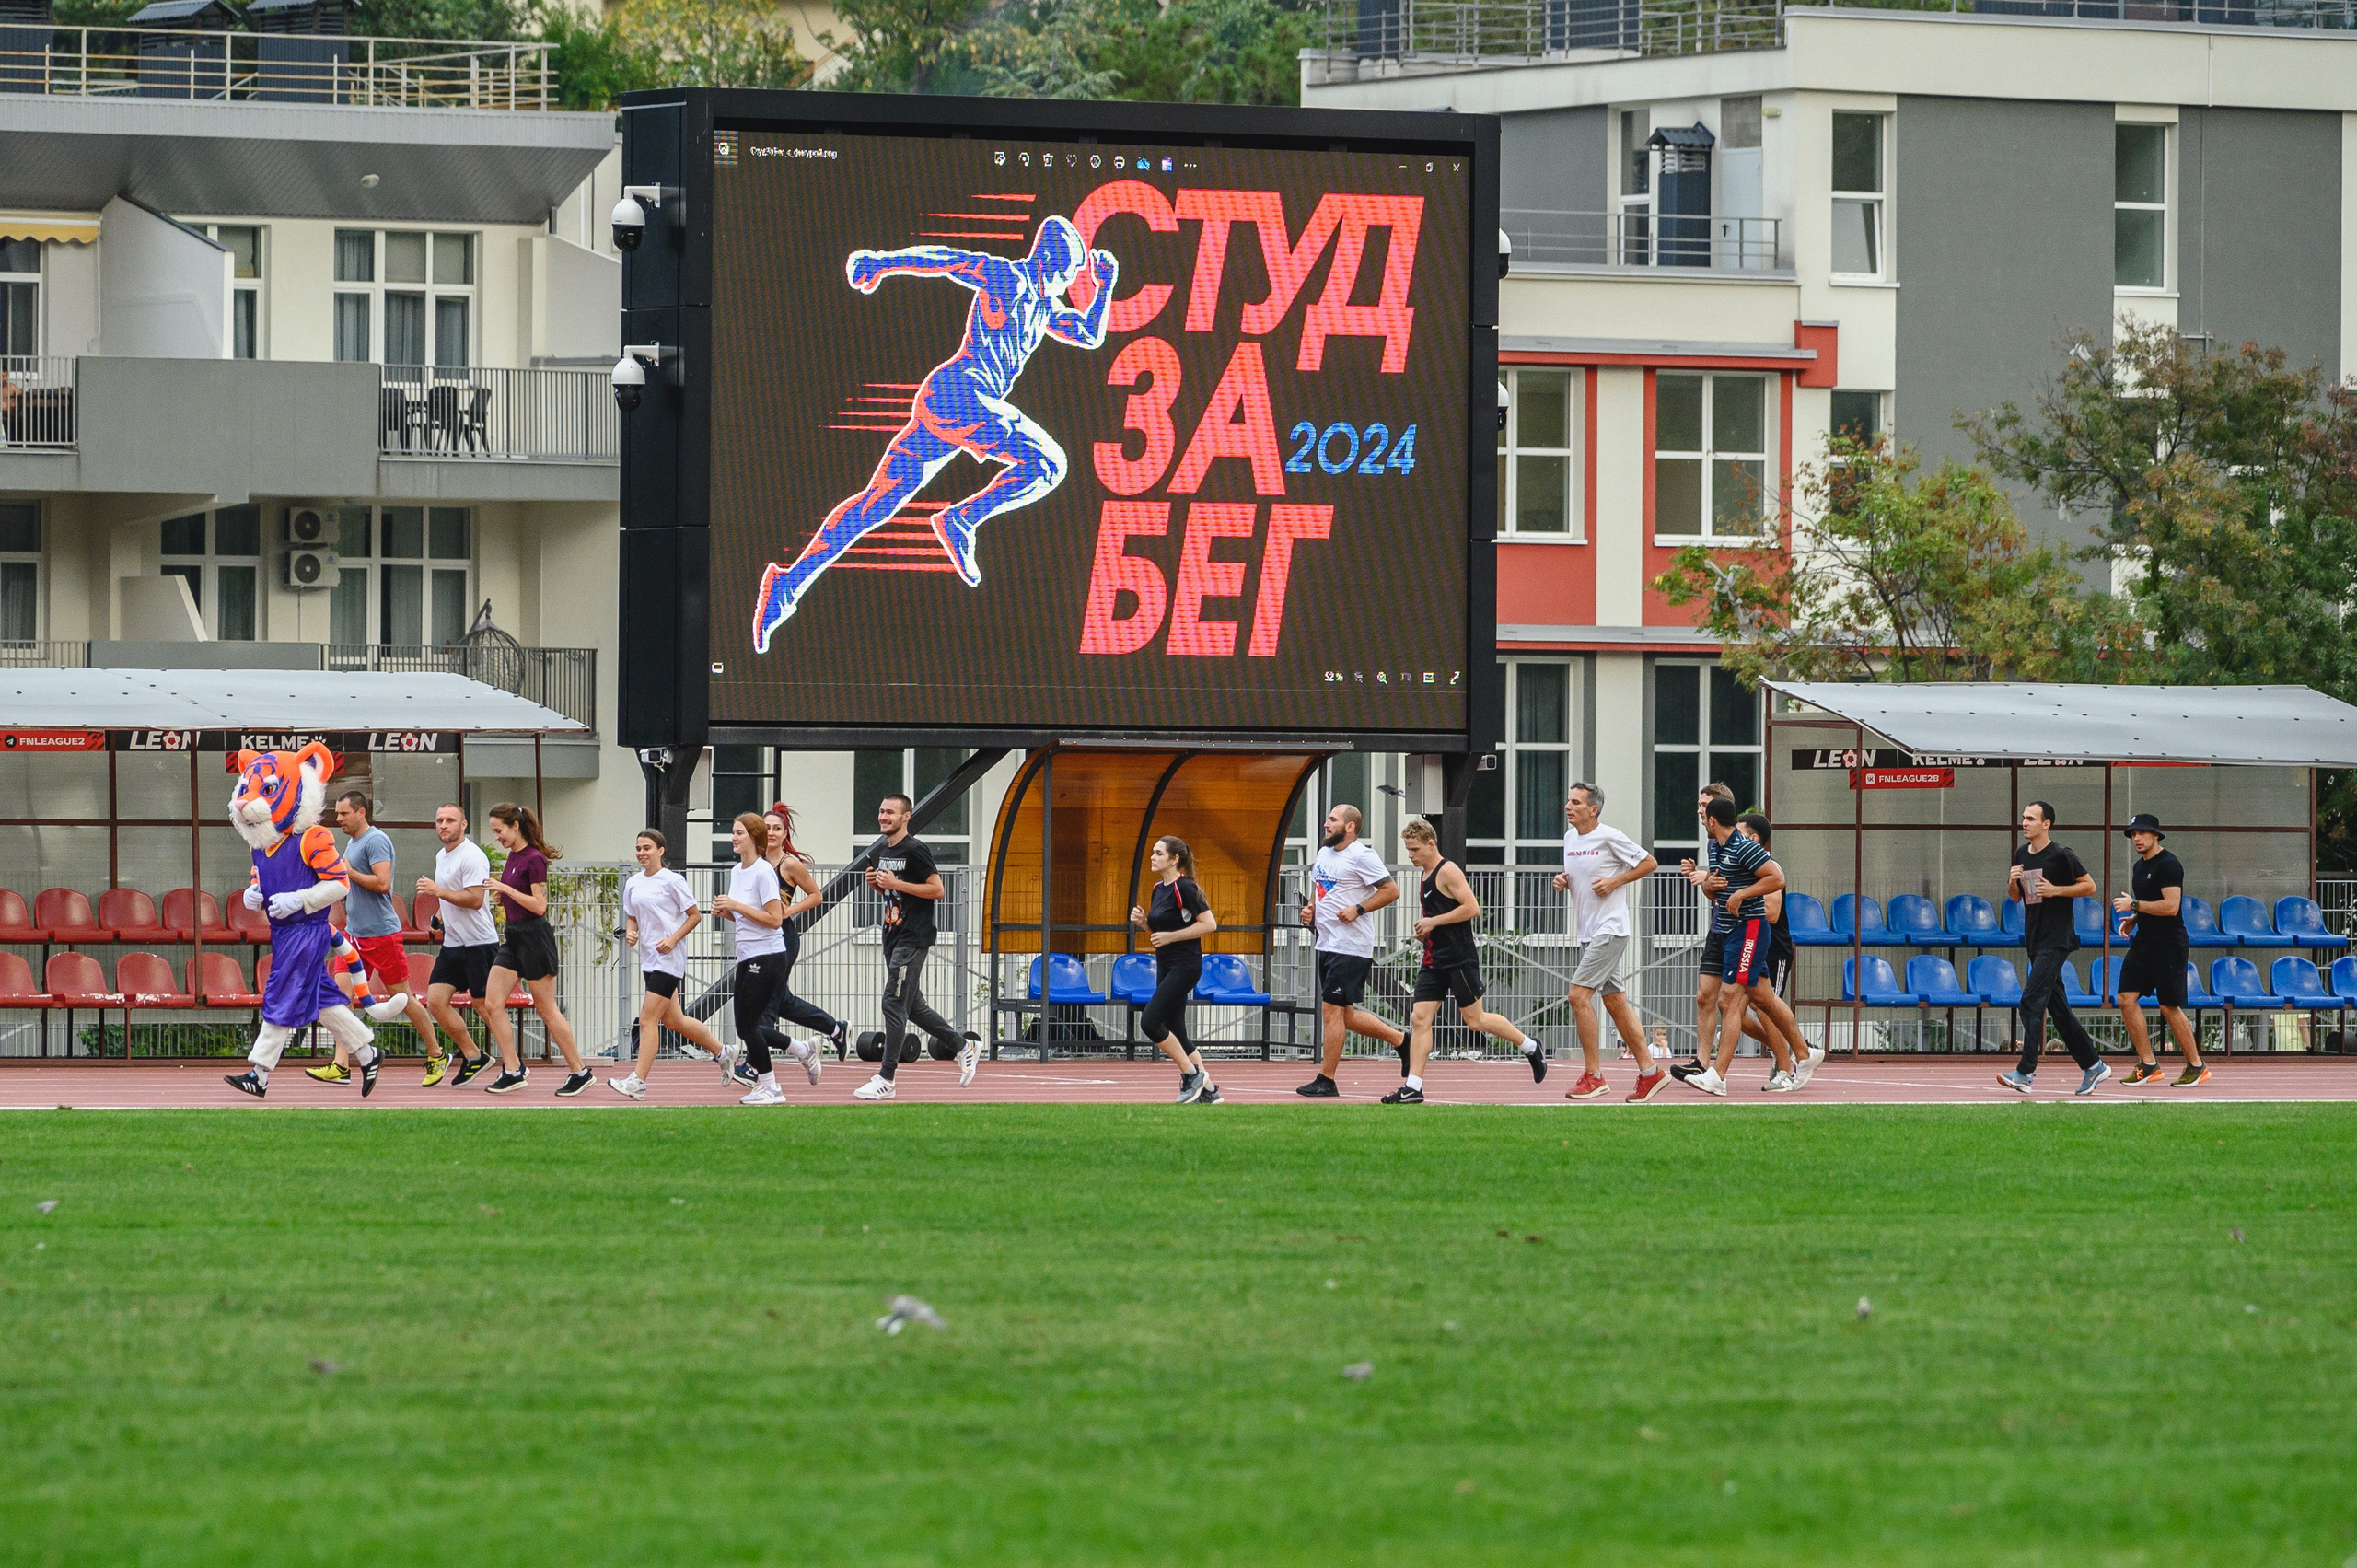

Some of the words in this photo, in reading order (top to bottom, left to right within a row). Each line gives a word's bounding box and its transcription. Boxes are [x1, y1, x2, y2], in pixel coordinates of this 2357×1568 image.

[1066, 180, 1424, 373] СТУД
[1093, 336, 1286, 495] ЗА
[1285, 421, 1418, 475] 2024
[1079, 501, 1334, 656] БЕГ
[19, 737, 86, 746] FNLEAGUE2
[240, 735, 309, 749] KELME
[367, 732, 438, 752] LEON
[1813, 749, 1876, 768] LEON
[1878, 774, 1939, 783] FNLEAGUE2B
